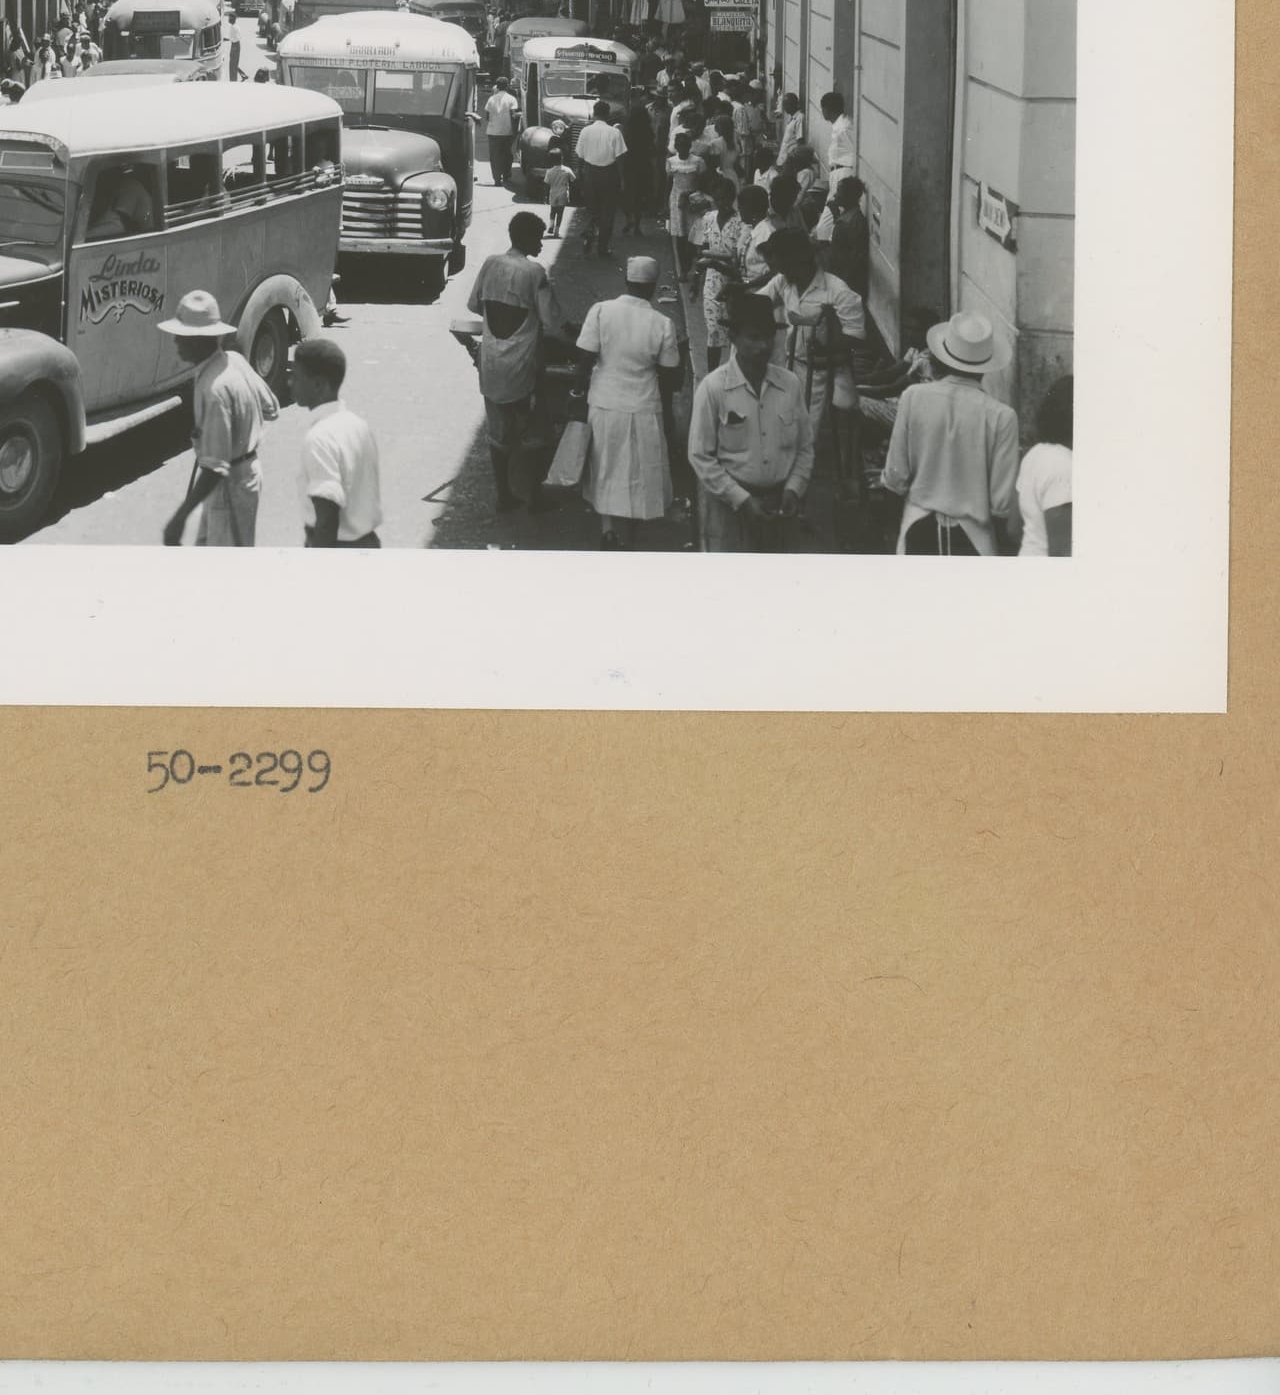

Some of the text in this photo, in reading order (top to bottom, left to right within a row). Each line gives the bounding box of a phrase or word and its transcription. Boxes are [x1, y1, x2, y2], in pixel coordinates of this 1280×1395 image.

[88, 251, 161, 283] Linda
[79, 280, 166, 322] MISTERIOSA
[147, 748, 332, 794] 50-2299
